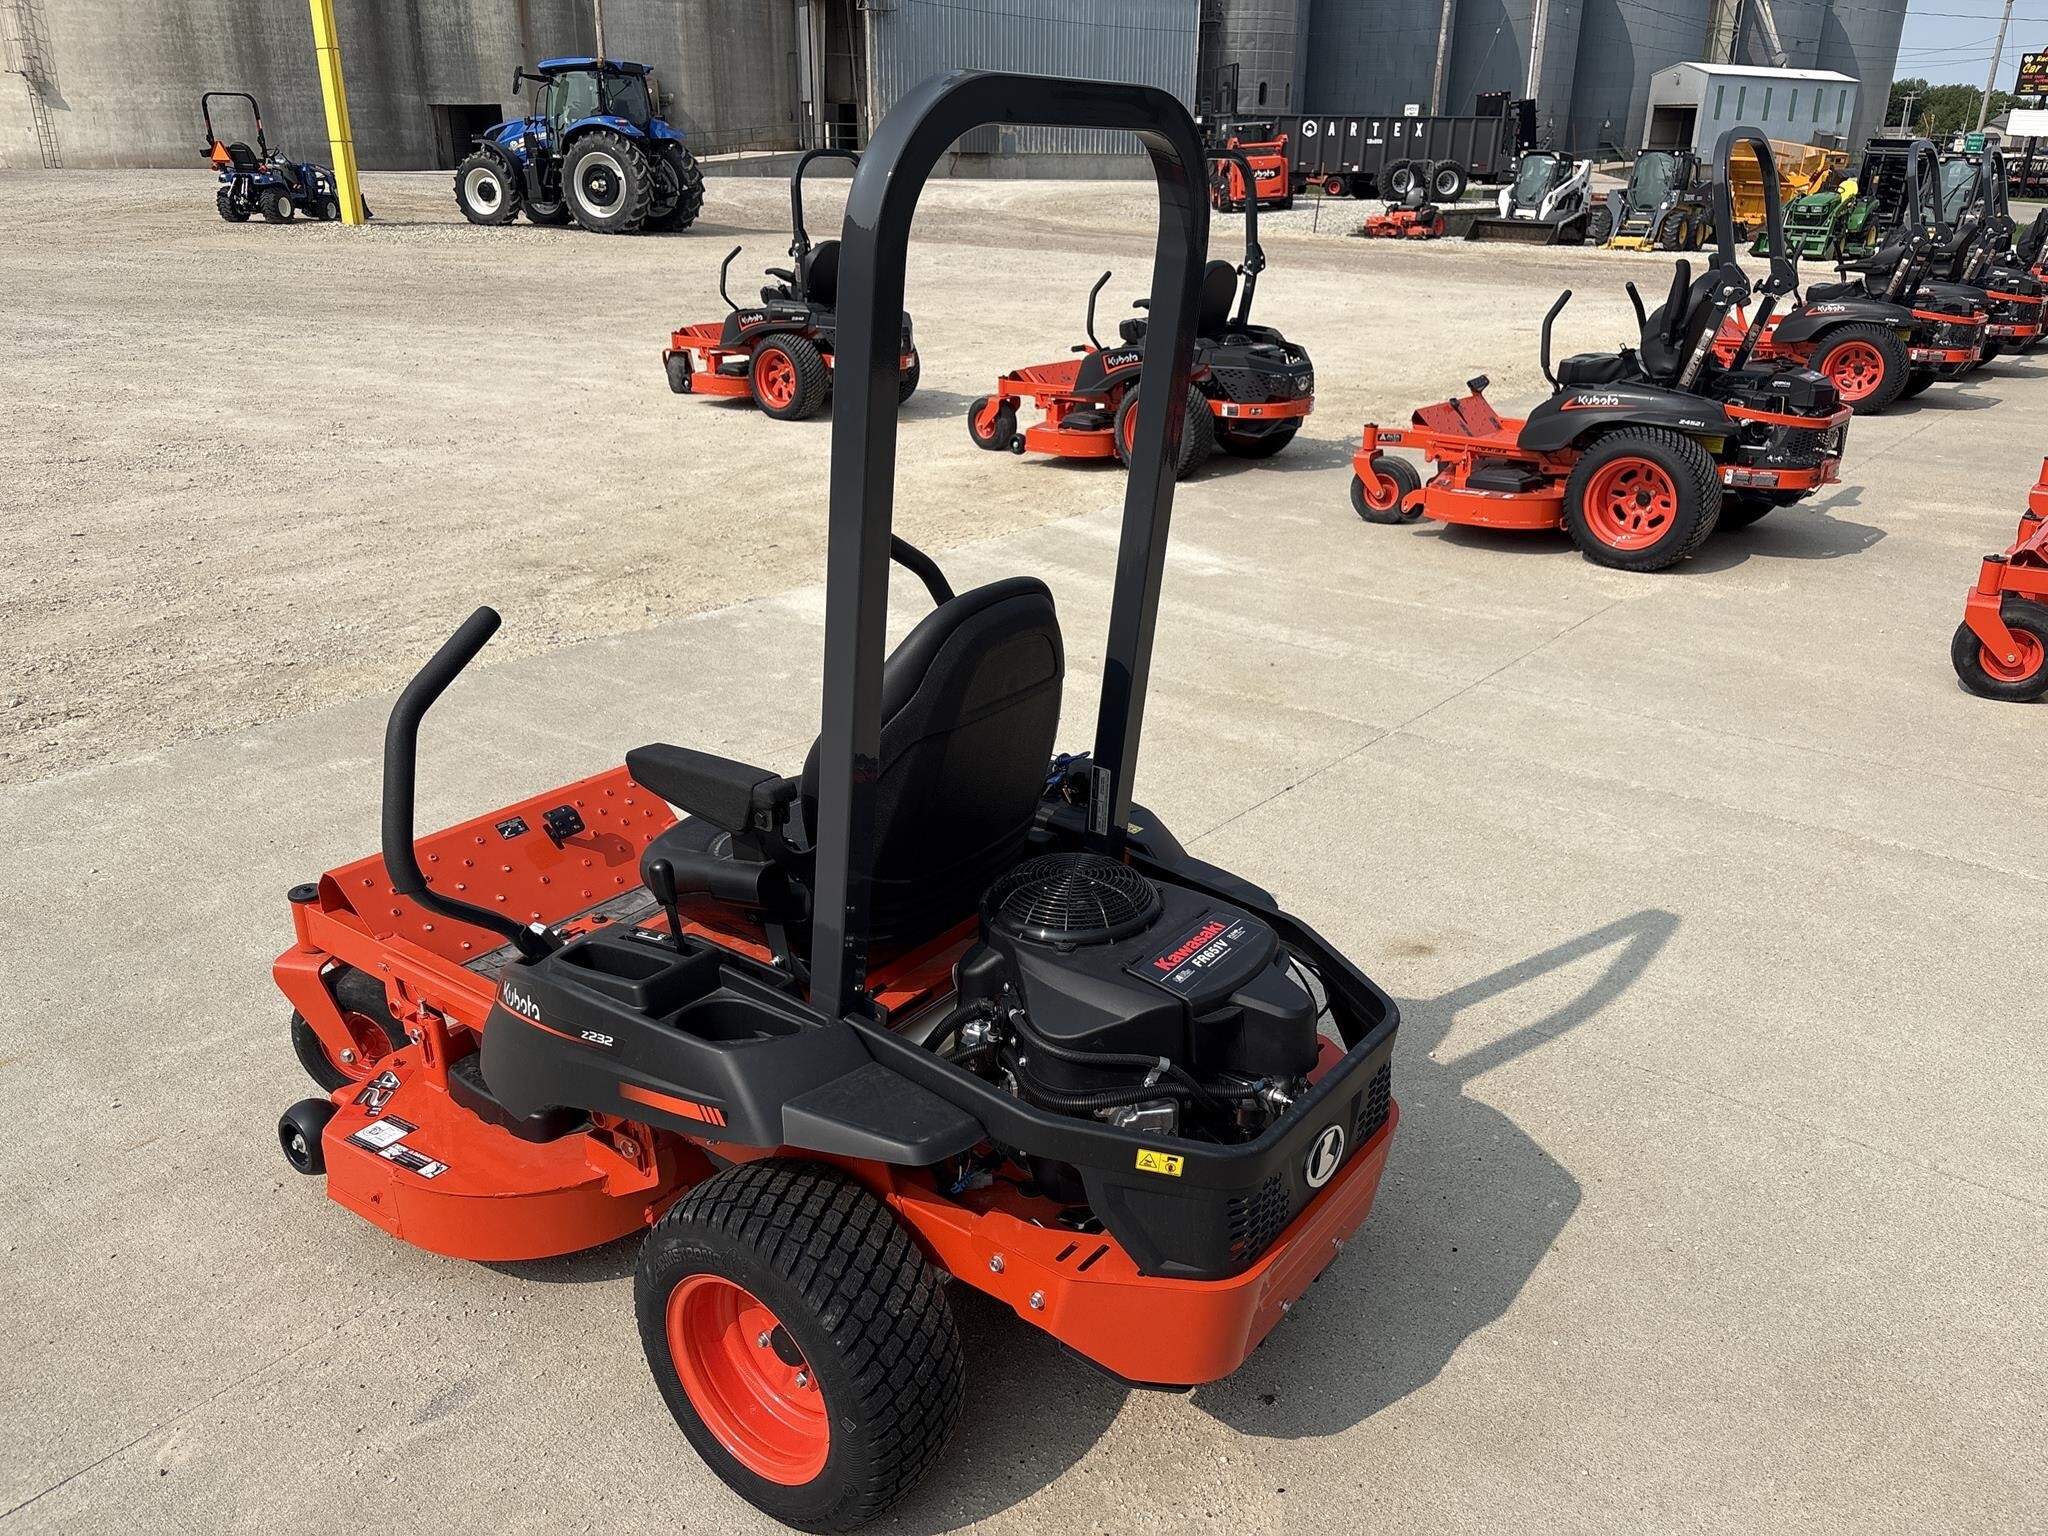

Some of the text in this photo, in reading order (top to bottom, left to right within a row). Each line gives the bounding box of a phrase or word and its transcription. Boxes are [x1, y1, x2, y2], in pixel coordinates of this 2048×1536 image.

[2022, 63, 2042, 74] Car
[1328, 122, 1424, 137] ARTEX
[1253, 169, 1275, 177] ubota
[741, 313, 764, 324] Kubota
[1107, 353, 1139, 366] Kubota
[1577, 394, 1619, 406] Kubota
[1153, 920, 1227, 971] Kawasaki
[1191, 938, 1228, 968] FR651V
[502, 978, 541, 1021] Kubota
